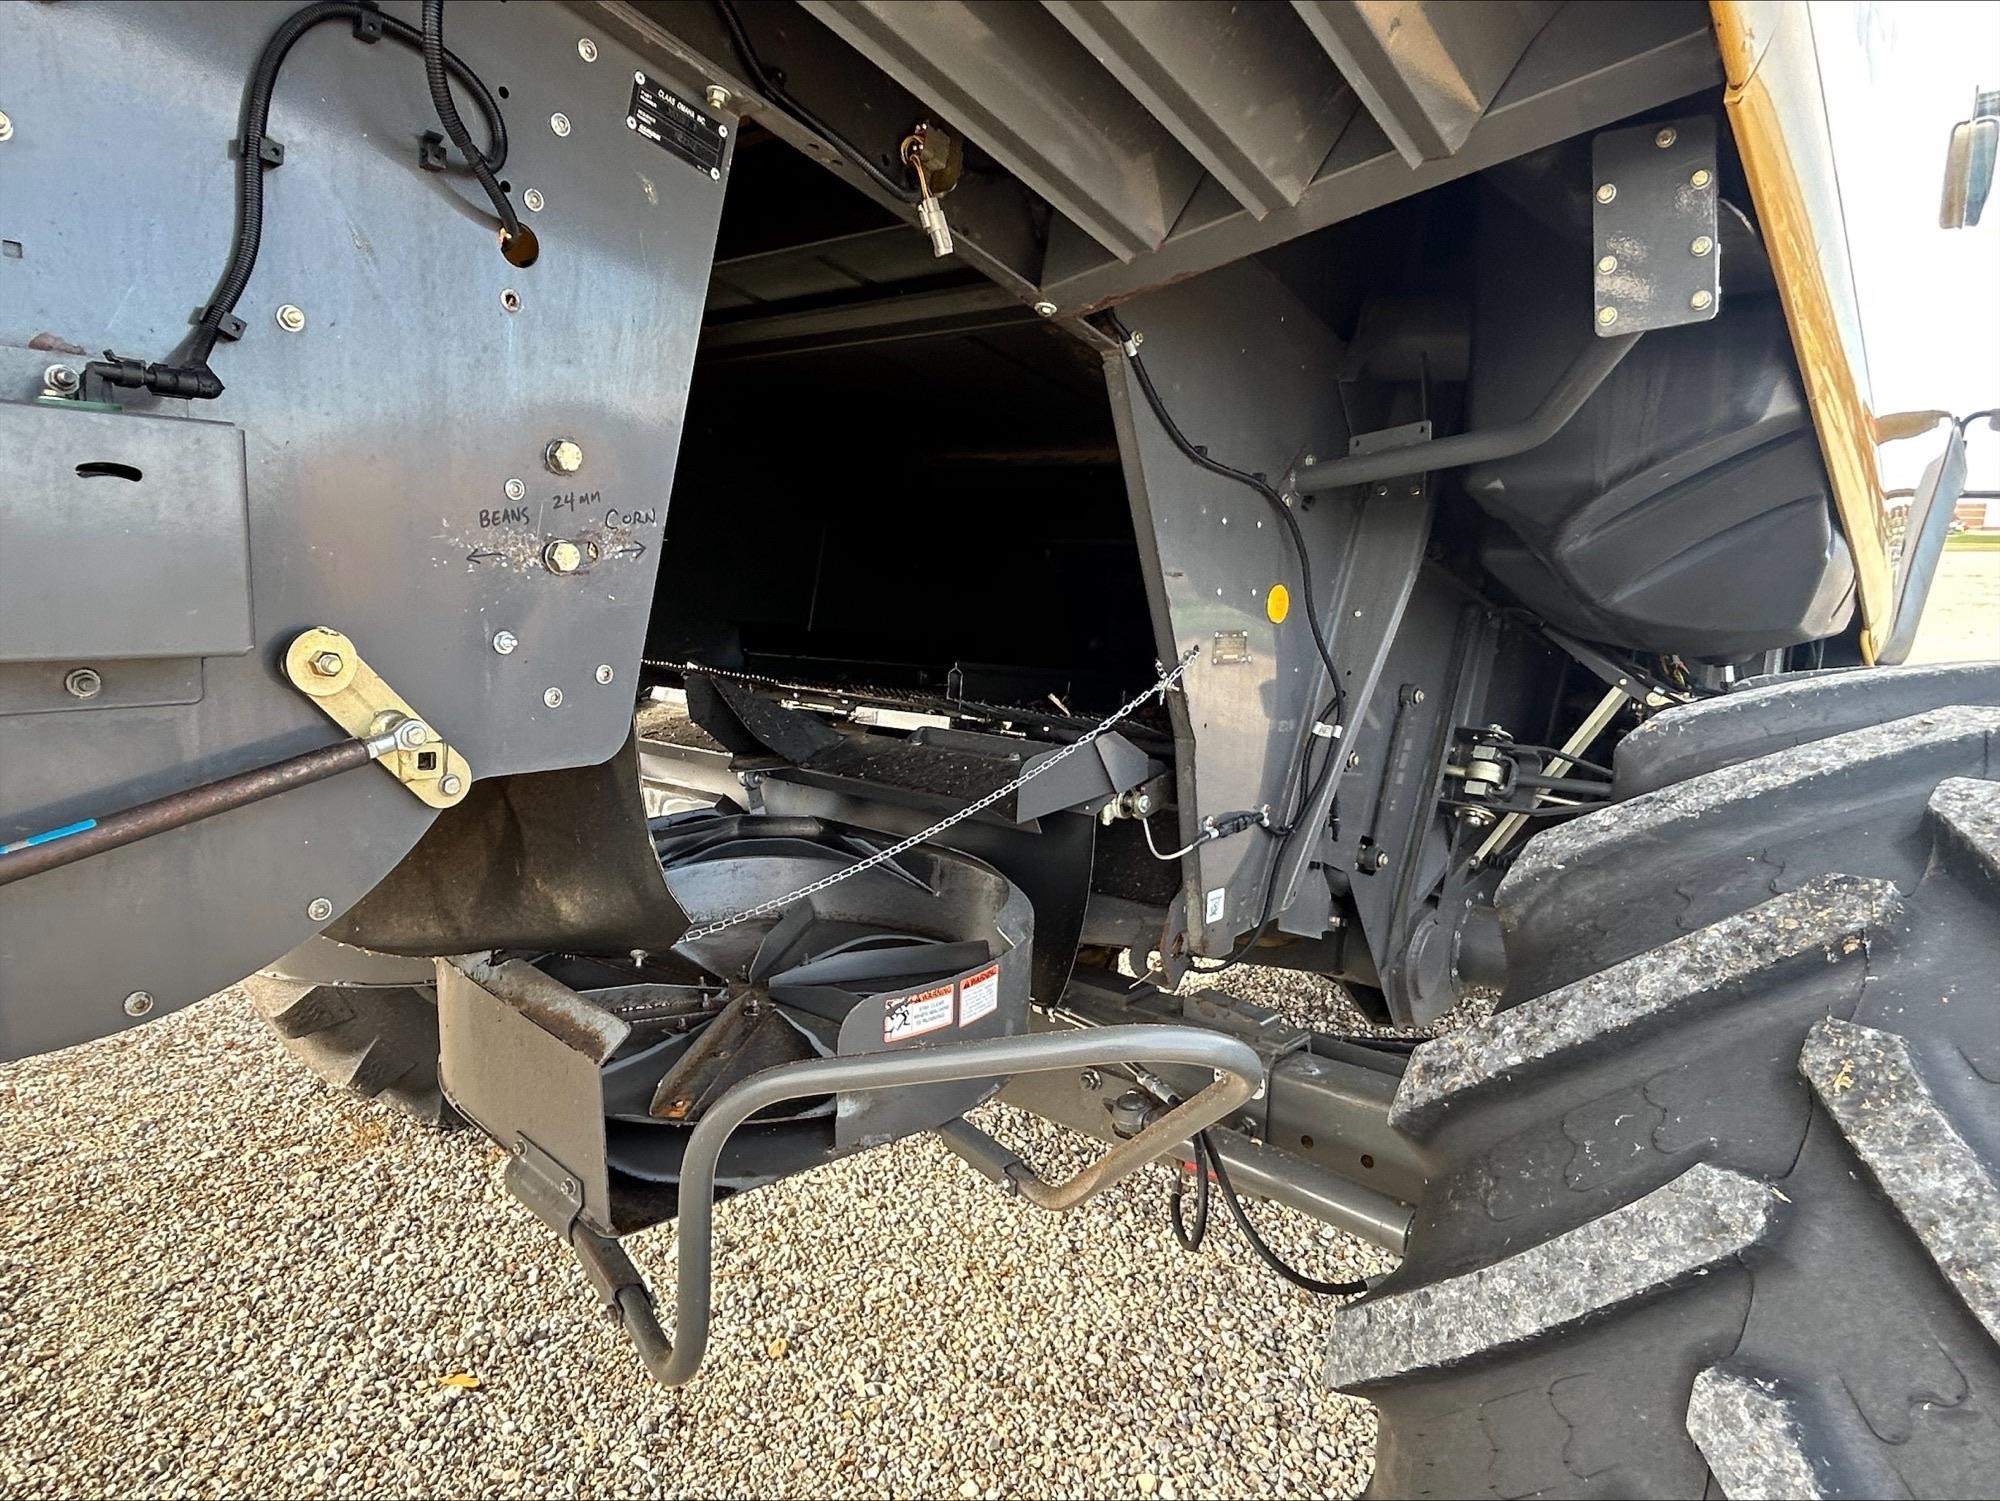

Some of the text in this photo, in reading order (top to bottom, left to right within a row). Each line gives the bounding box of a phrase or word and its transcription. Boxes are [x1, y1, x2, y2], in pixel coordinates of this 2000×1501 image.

[658, 89, 676, 106] CLAAS
[677, 102, 695, 119] OMAHA
[479, 506, 530, 528] BEANS
[970, 966, 998, 987] WARNING
[921, 986, 952, 1001] WARNING
